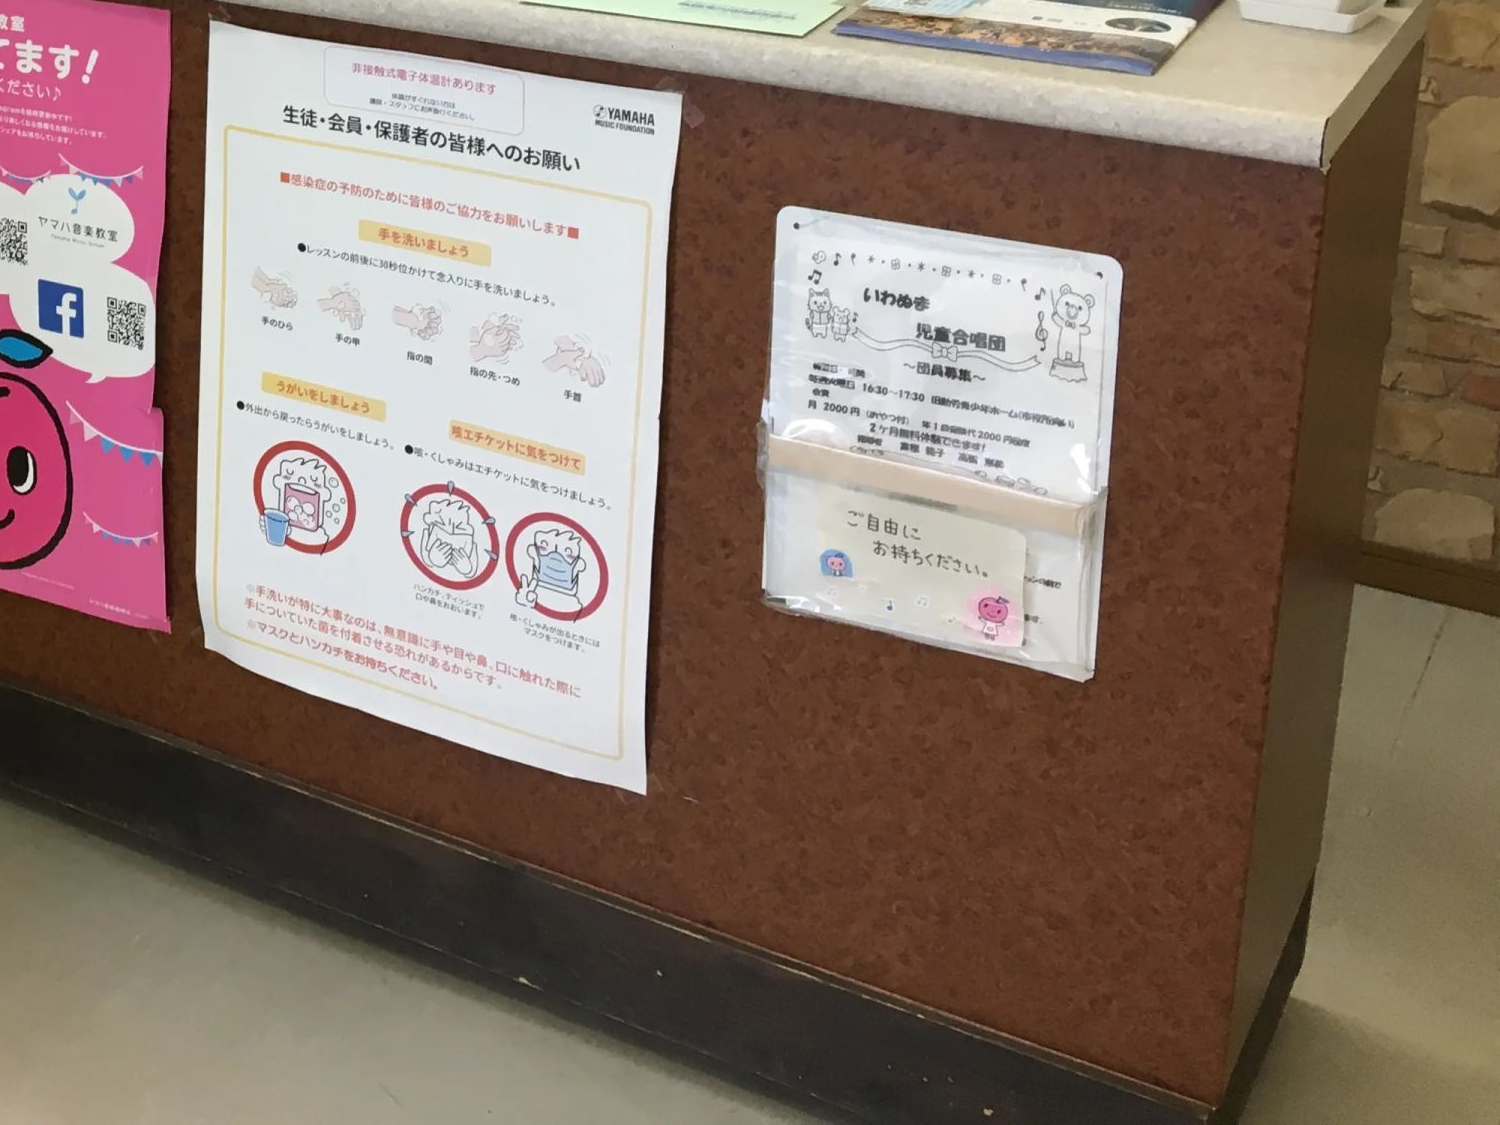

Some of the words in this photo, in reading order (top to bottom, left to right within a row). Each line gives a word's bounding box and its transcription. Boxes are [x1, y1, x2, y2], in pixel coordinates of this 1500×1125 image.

[595, 119, 615, 129] MUSIC
[616, 122, 655, 135] FOUNDATION
[608, 107, 655, 126] YAMAHA
[282, 104, 580, 172] 生徒・会員・保護者の皆様へのお願い
[38, 216, 118, 242] ヤマハ音楽教室
[378, 227, 470, 258] 手を洗いましょう
[863, 287, 930, 311] いわぬま
[261, 316, 293, 331] 手のひら
[335, 333, 360, 347] 手の甲
[916, 323, 1006, 352] 児童合唱団
[406, 350, 433, 366] 指の間
[470, 366, 520, 387] 指の先・つめ
[276, 380, 370, 414] うがいをしましょう
[564, 389, 582, 403] 手首
[823, 402, 848, 414] 2000
[451, 425, 582, 471] 咳エチケットに気をつけて
[847, 510, 921, 540] ご自由に
[872, 539, 989, 578] お持ちください。
